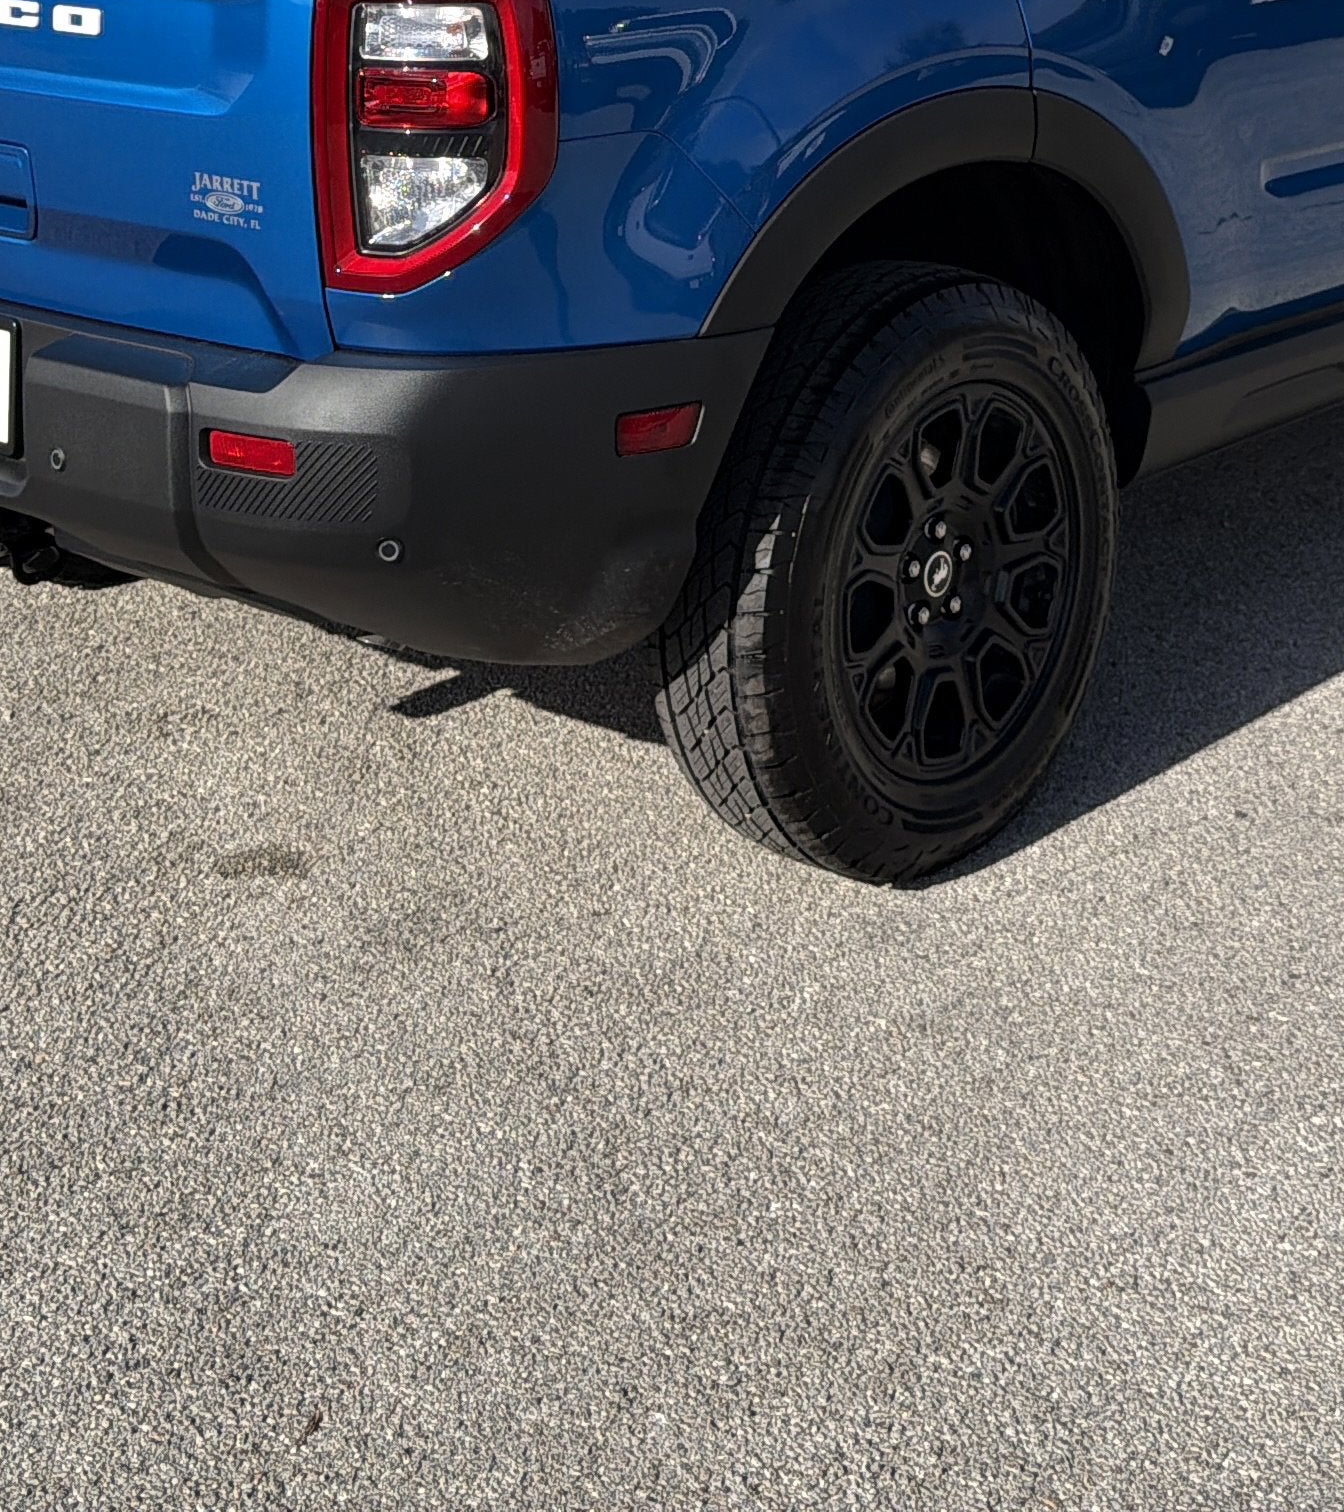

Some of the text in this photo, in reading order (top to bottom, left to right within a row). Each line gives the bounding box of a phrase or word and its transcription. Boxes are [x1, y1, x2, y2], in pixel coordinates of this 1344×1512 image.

[191, 171, 261, 200] JARRETT
[193, 209, 261, 230] DADE CITY, FL
